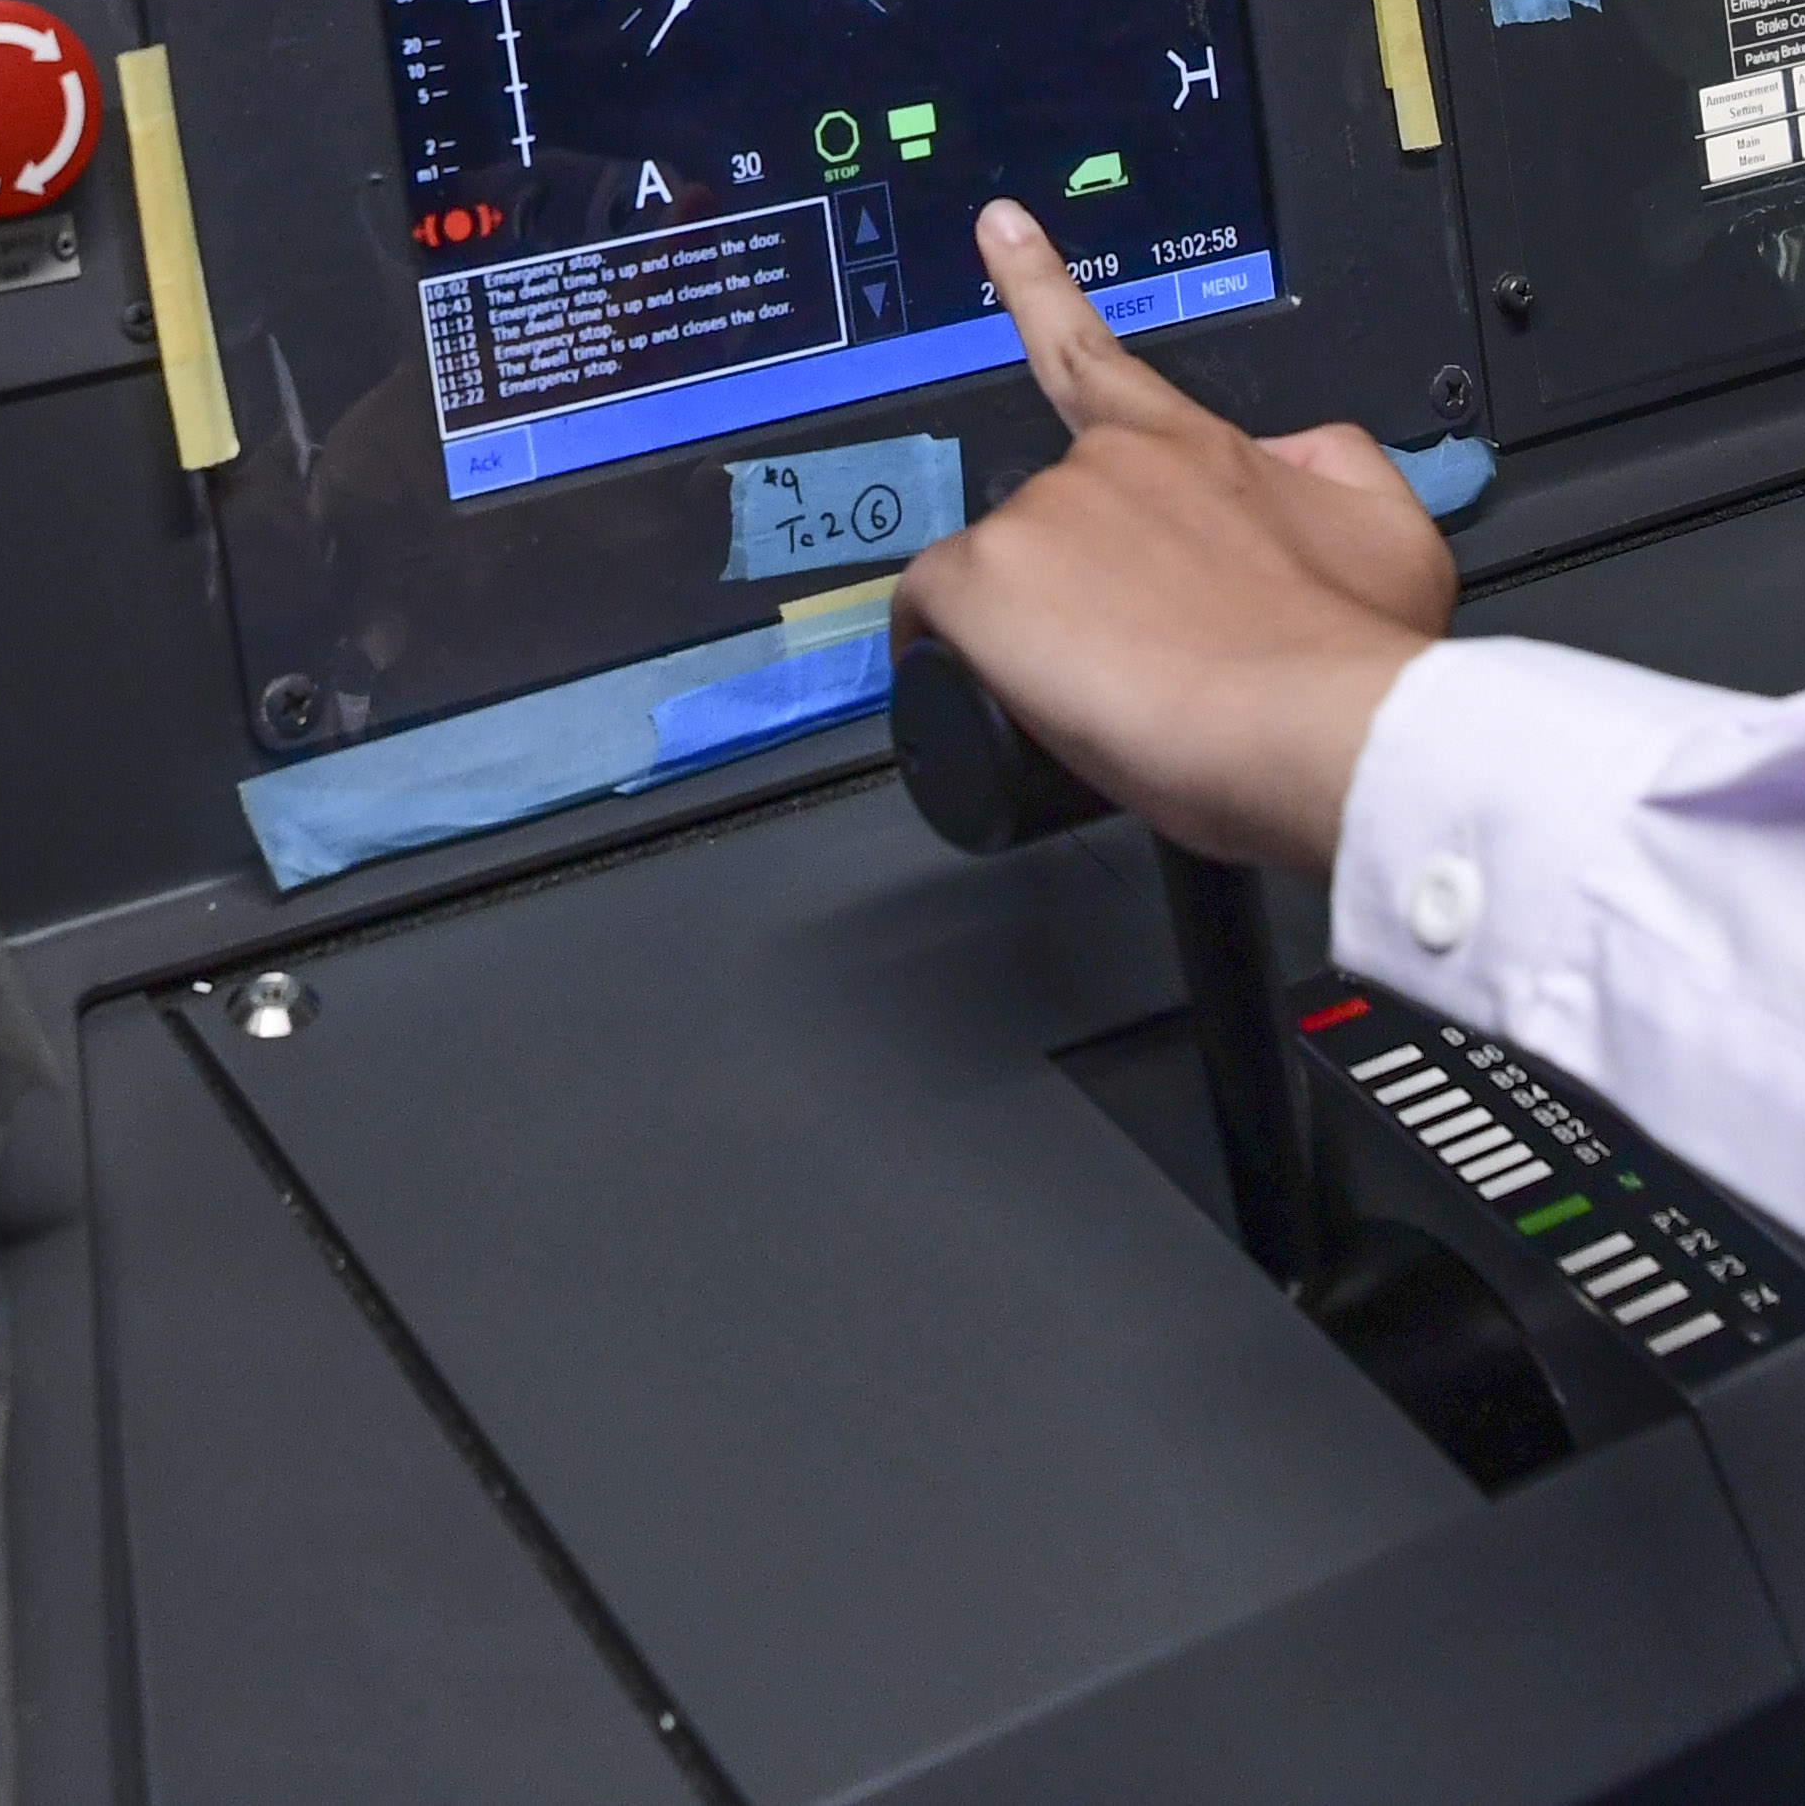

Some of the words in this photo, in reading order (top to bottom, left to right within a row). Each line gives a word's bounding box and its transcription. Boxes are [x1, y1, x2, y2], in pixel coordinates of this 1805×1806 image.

[1755, 17, 1789, 36] Brake
[403, 37, 422, 55] 20
[1744, 50, 1781, 67] Parking
[418, 88, 430, 104] 5
[1705, 81, 1779, 108] Announcement
[426, 139, 436, 156] 2
[731, 151, 762, 180] 30
[824, 164, 860, 182] STOP
[636, 160, 673, 209] A
[1151, 226, 1238, 265] 13:02:58
[483, 261, 565, 289] Emergency
[486, 289, 516, 306] The
[518, 278, 559, 300] dwell
[562, 272, 598, 290] time
[601, 268, 616, 282] is
[618, 263, 639, 280] up
[641, 254, 669, 274] and
[671, 246, 719, 267] closes
[720, 240, 746, 256] the
[748, 233, 786, 250] door.
[1202, 273, 1248, 299] MENU
[1104, 294, 1155, 321] RESET
[469, 451, 501, 475] Ack
